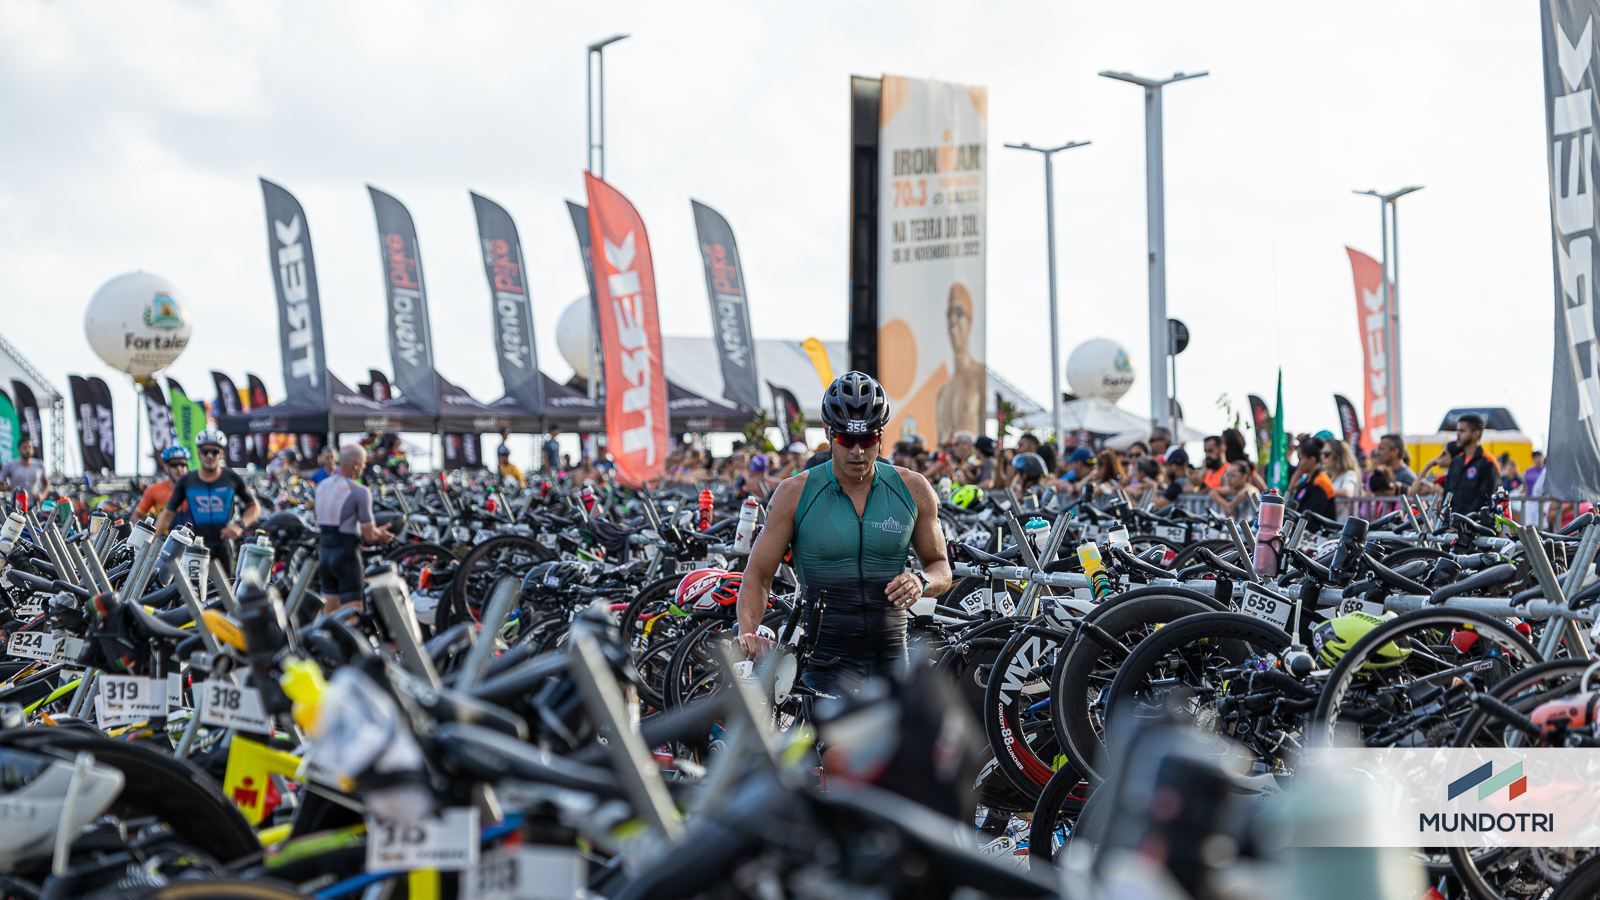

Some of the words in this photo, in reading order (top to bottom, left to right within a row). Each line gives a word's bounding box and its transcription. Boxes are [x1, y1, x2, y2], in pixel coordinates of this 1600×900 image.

[847, 422, 867, 433] 356
[680, 562, 696, 571] 670
[683, 577, 717, 602] LAZER
[1247, 593, 1277, 615] 659
[1262, 614, 1285, 627] TREK
[13, 633, 43, 649] 324
[999, 635, 1057, 706] ZAN
[106, 682, 139, 700] 319
[210, 686, 241, 709] 318
[998, 702, 1006, 729] CONCEPT
[1001, 728, 1014, 746] 88
[1006, 745, 1024, 771] CLINCHER
